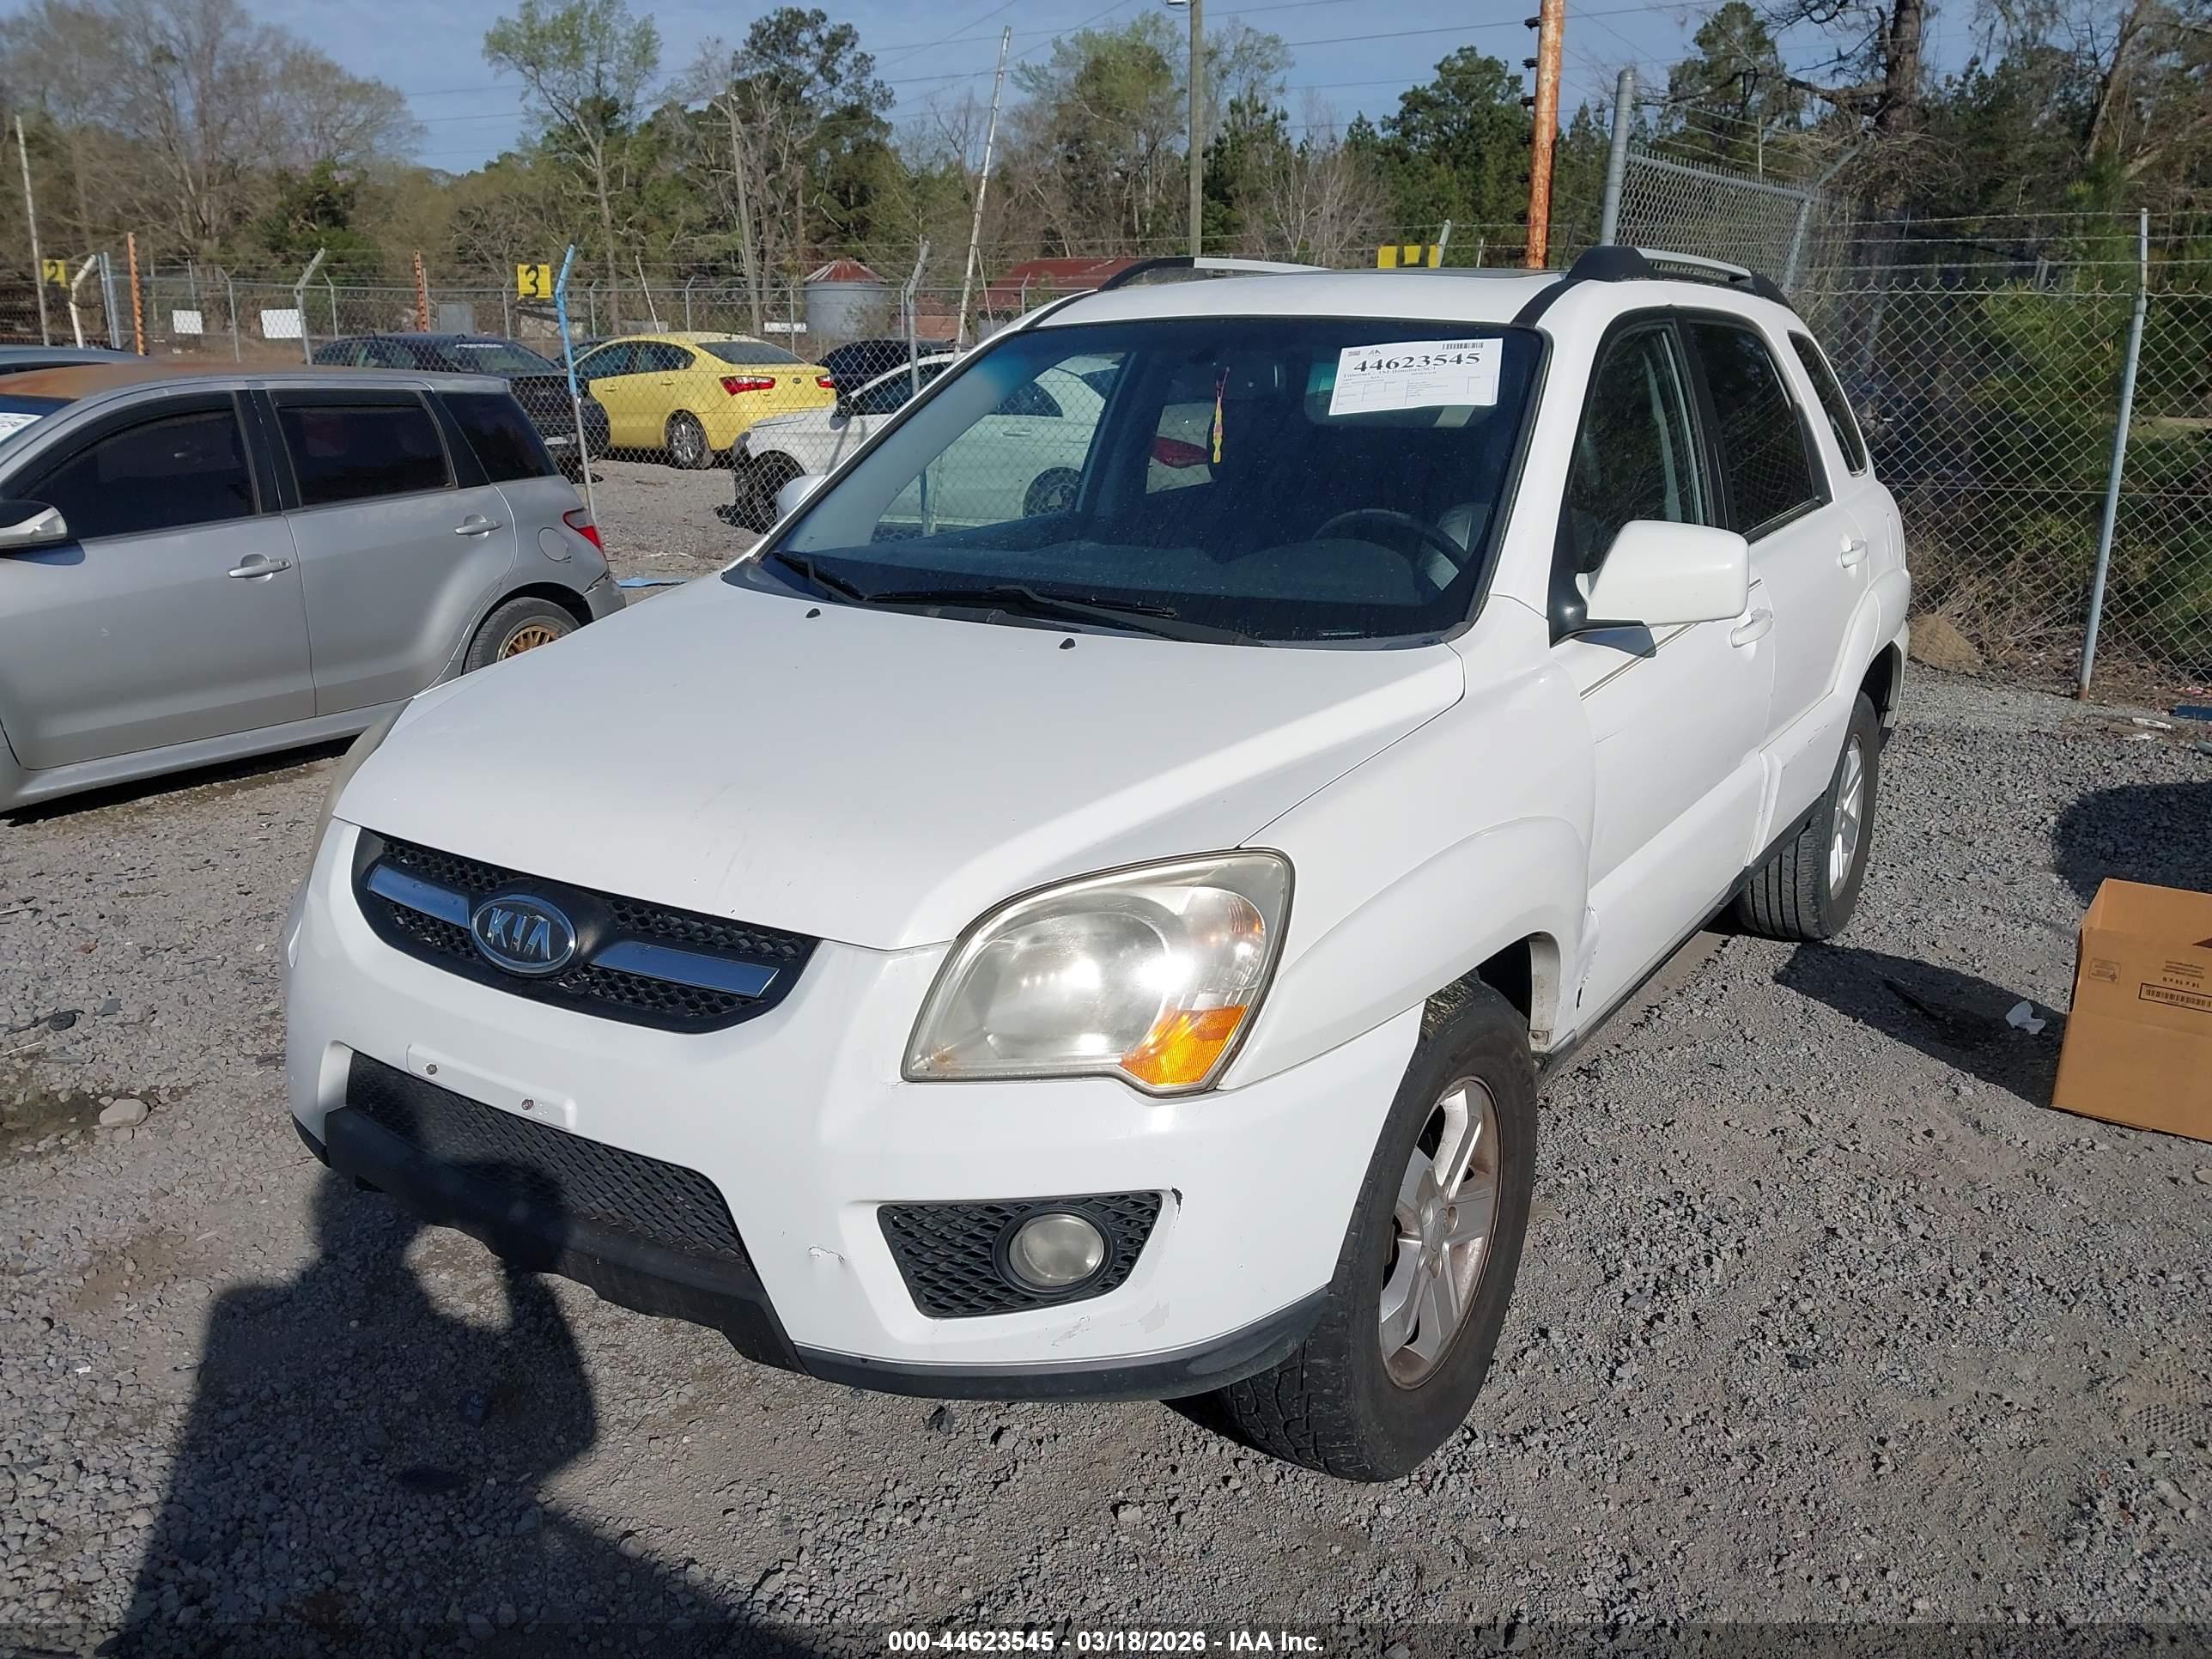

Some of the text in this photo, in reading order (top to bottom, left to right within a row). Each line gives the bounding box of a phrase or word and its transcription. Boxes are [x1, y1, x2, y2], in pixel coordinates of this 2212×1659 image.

[47, 260, 60, 285] 2
[523, 264, 539, 297] 3
[1353, 353, 1480, 372] 44623545
[487, 907, 550, 961] KIA
